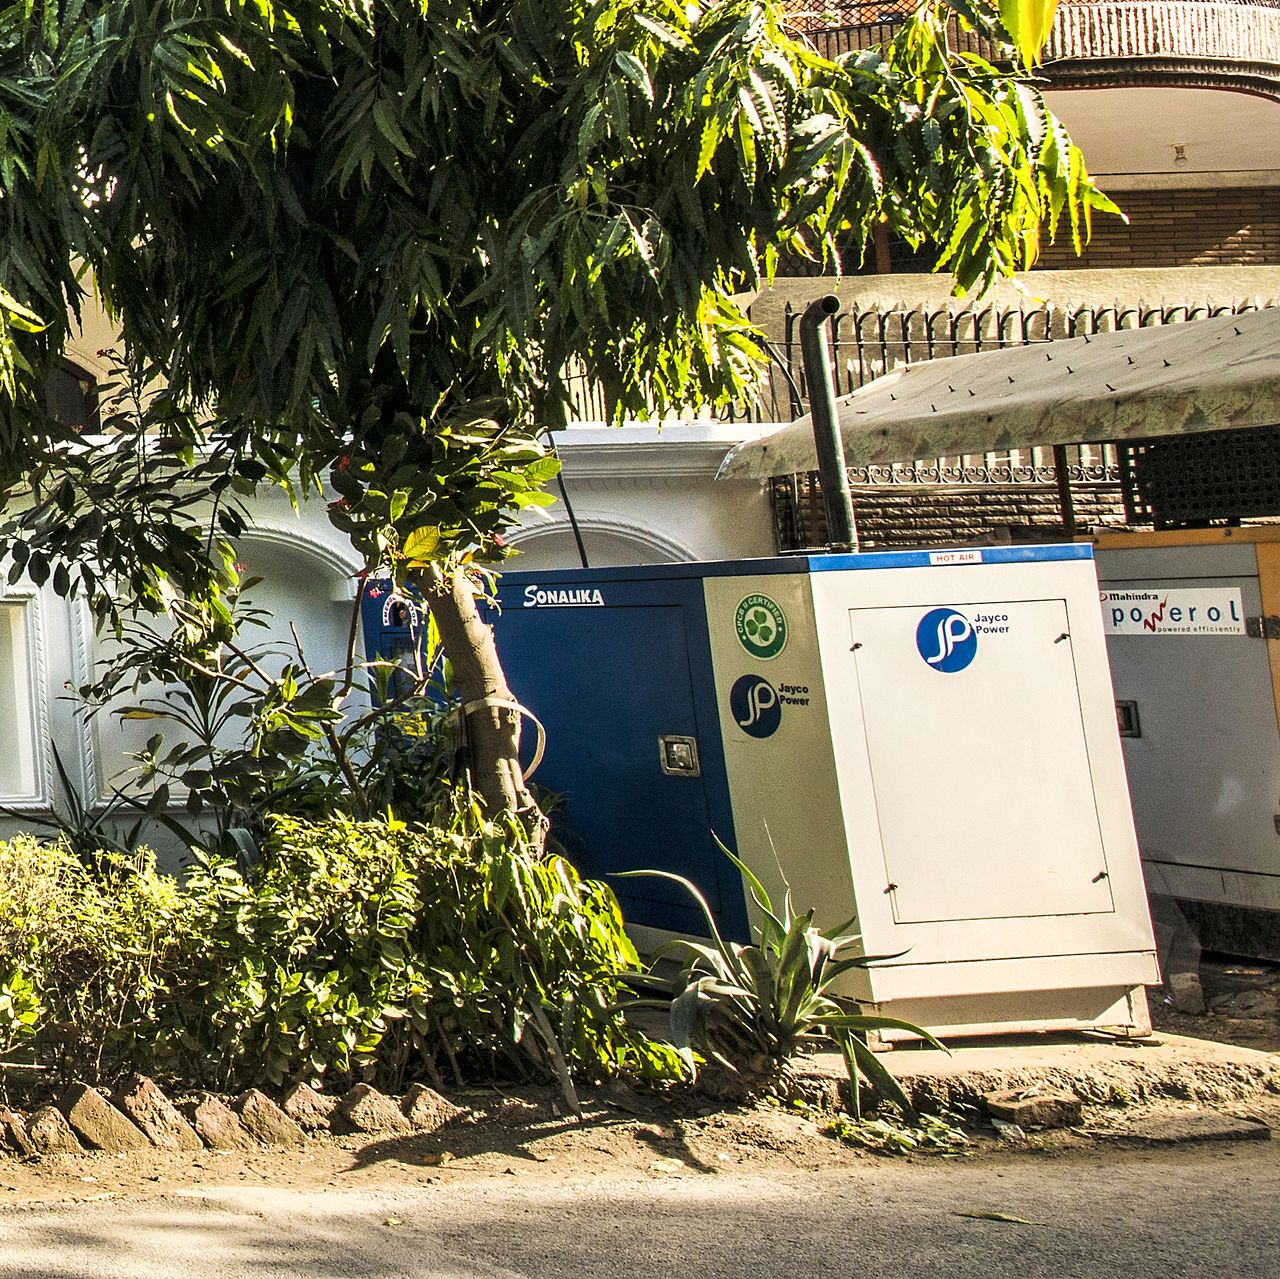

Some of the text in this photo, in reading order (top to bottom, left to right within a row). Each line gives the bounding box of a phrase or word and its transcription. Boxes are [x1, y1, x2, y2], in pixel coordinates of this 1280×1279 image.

[1109, 592, 1159, 601] Mahindra
[748, 596, 783, 624] CERTIFIED
[974, 613, 1009, 625] Jayco
[975, 625, 1010, 635] Power
[1193, 625, 1241, 633] efficiently
[778, 683, 809, 695] Jayco
[779, 694, 810, 706] Power
